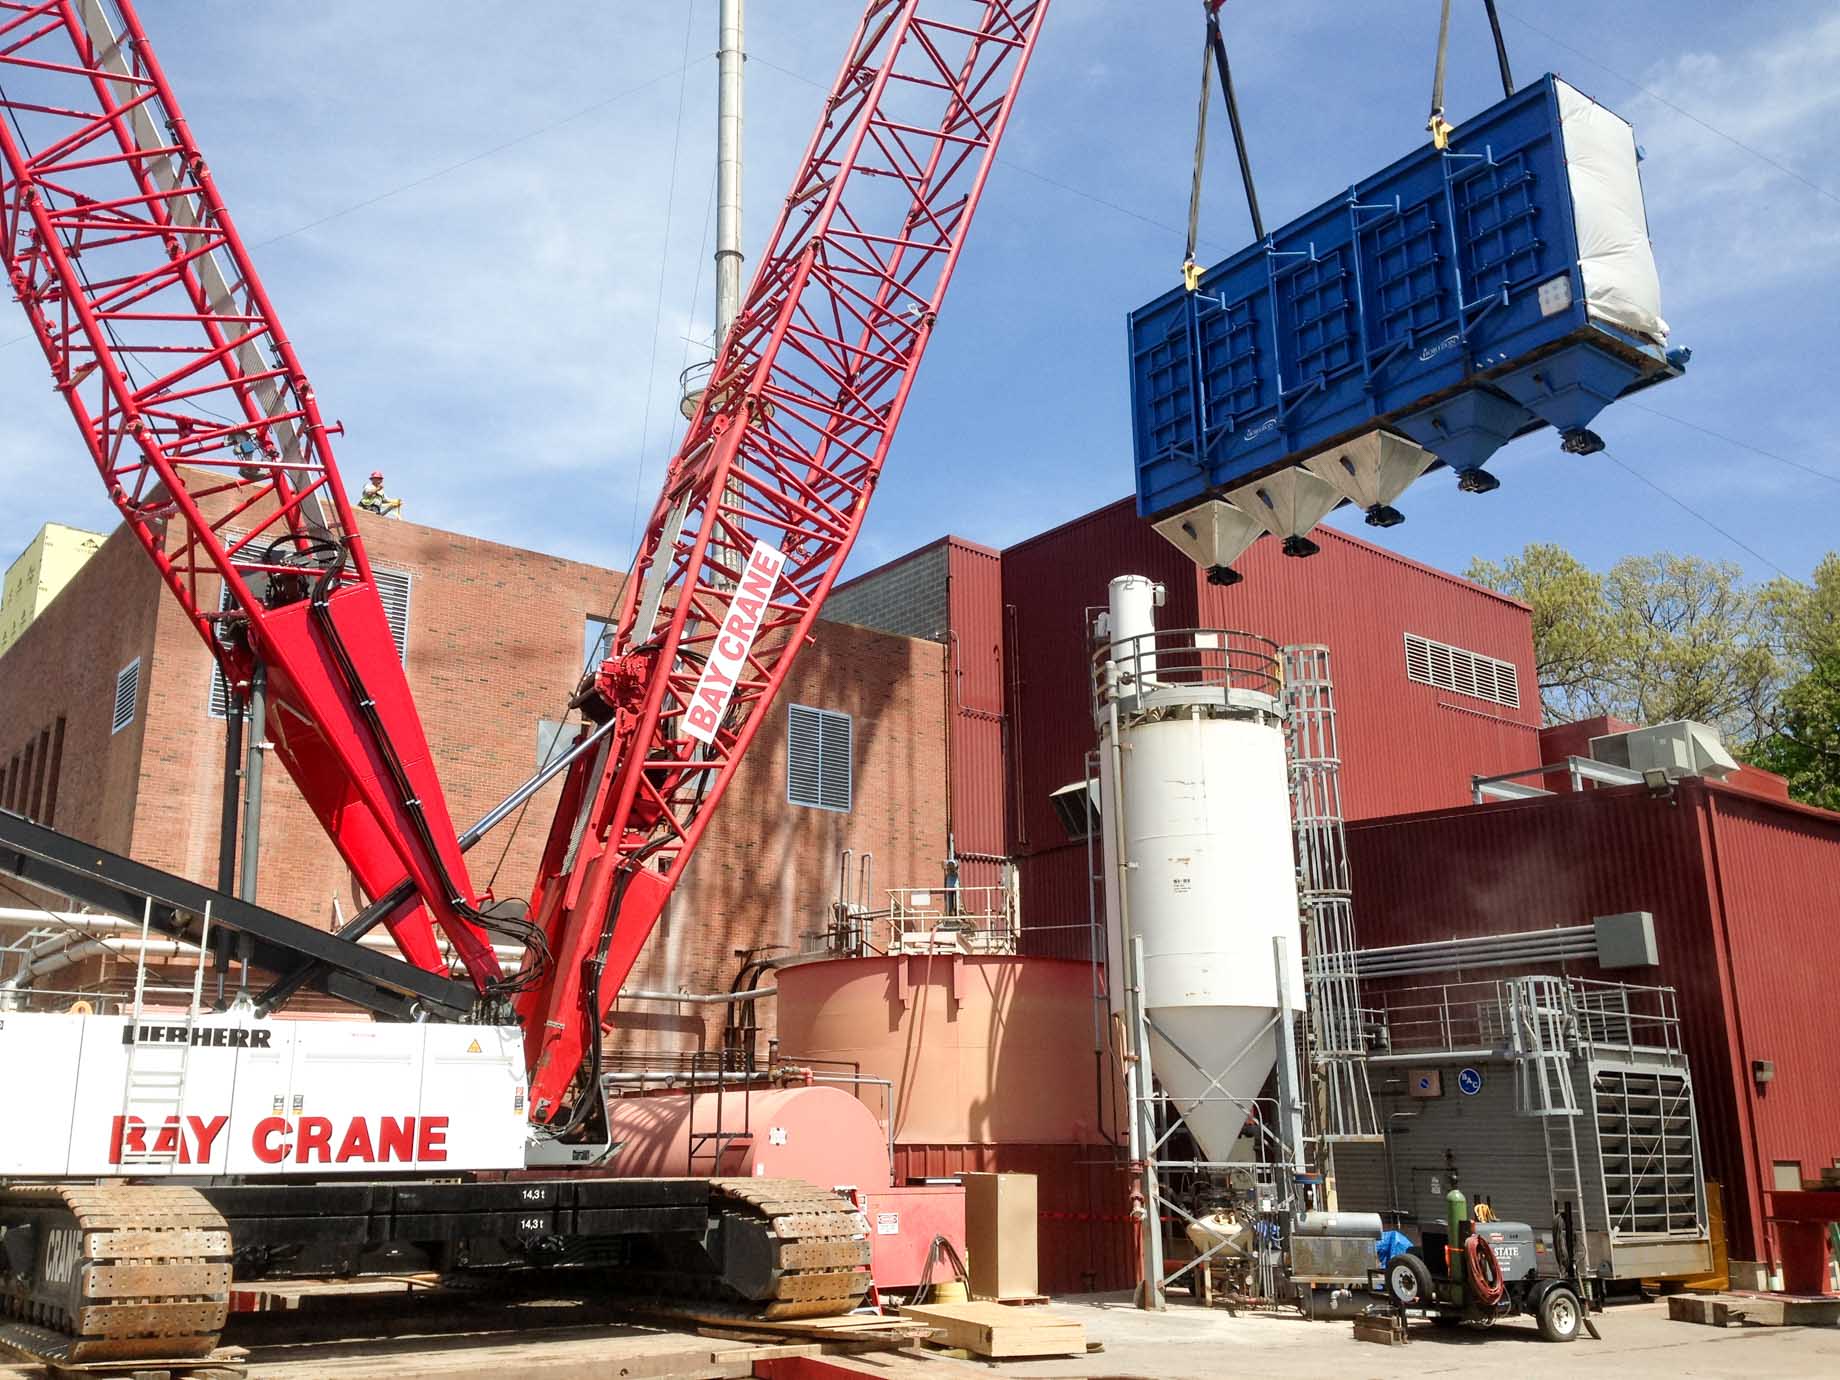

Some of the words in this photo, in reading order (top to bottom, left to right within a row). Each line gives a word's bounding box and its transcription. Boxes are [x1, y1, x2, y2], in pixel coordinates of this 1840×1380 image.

[688, 661, 732, 733] BAY
[718, 551, 780, 661] CRANE
[108, 1115, 229, 1164] BAY
[251, 1115, 449, 1163] CRANE
[1494, 1246, 1519, 1257] STATE
